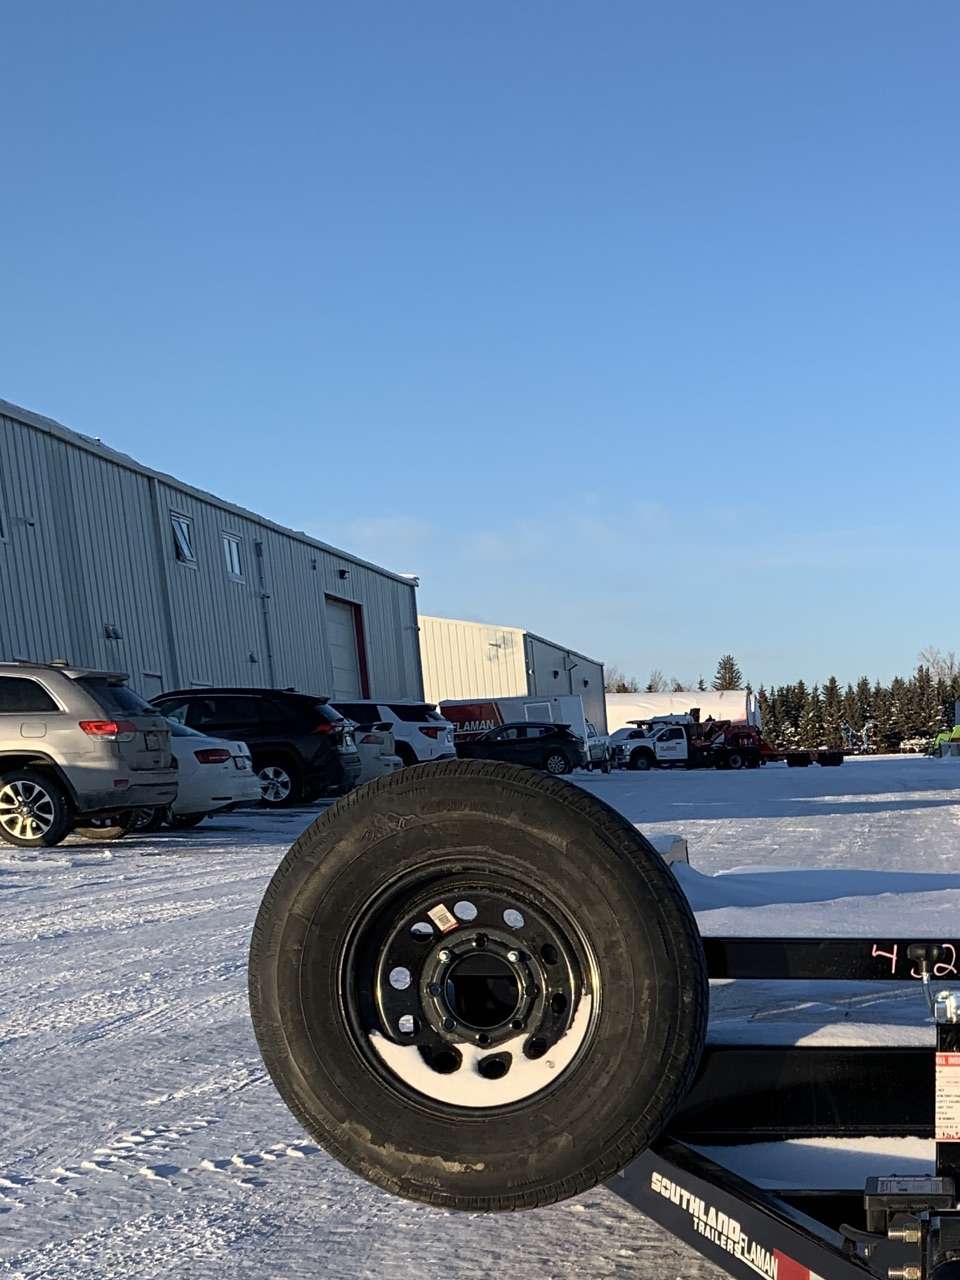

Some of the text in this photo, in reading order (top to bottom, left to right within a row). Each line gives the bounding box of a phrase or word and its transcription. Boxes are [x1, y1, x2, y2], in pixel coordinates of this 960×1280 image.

[651, 1171, 741, 1242] SOUTHLAND
[693, 1217, 741, 1259] TRAILERS
[740, 1231, 778, 1280] FLAMAN
